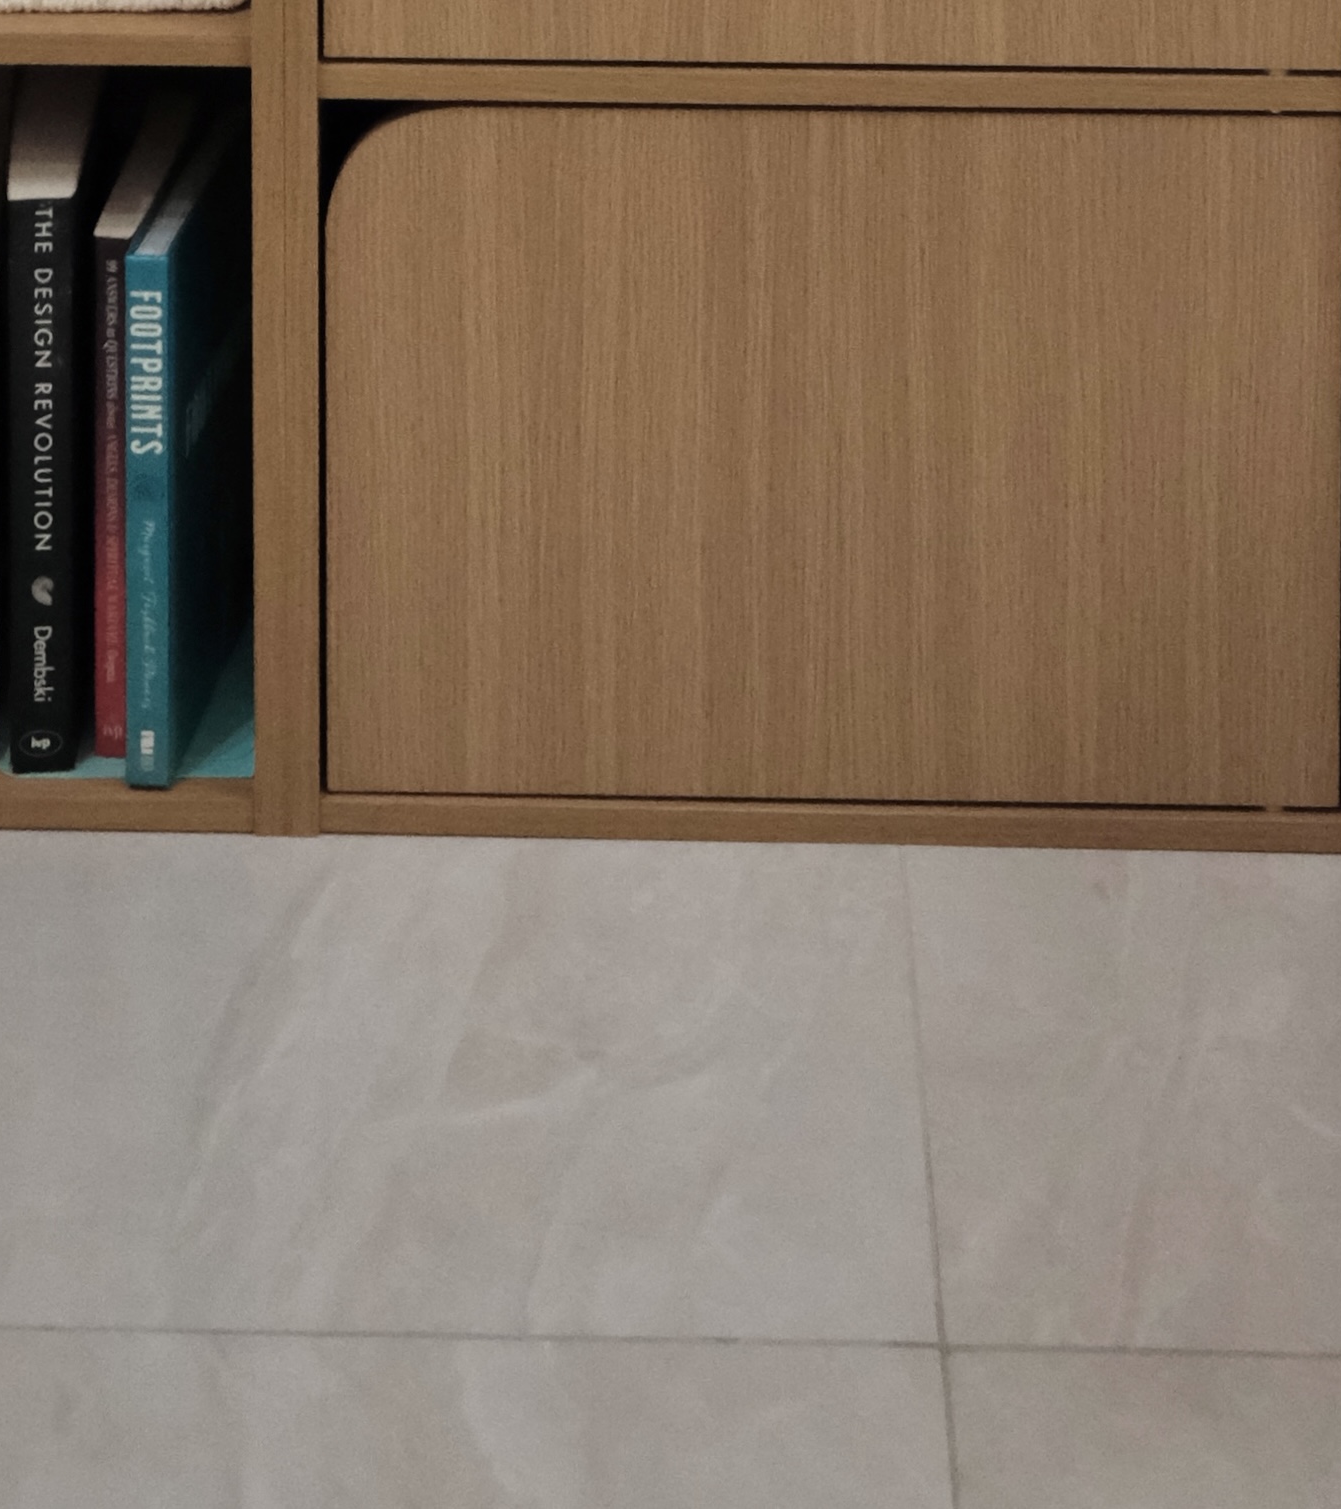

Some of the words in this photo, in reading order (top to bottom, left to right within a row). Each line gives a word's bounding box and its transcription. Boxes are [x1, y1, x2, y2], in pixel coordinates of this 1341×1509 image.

[33, 207, 53, 253] THE
[33, 268, 53, 368] DESIGN
[130, 289, 163, 455] FOOTPRINTS
[33, 382, 53, 552] REVOLUTION
[32, 626, 53, 702] Dembski
